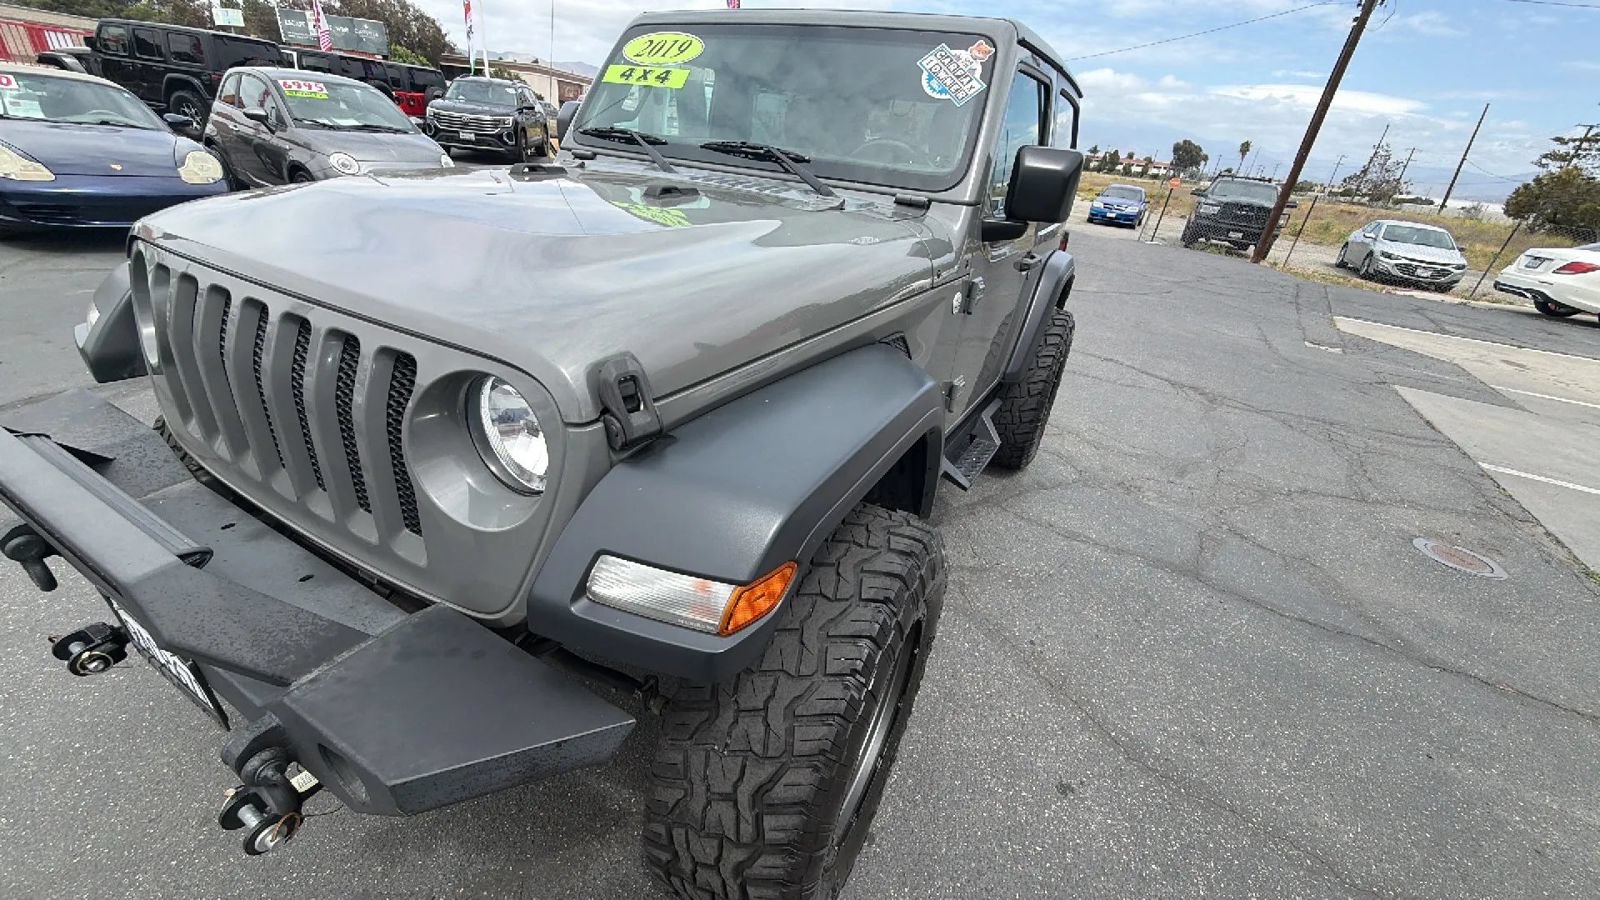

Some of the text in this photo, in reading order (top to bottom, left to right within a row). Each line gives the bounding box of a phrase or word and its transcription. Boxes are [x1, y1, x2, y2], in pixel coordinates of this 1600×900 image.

[633, 39, 694, 58] 2019
[930, 63, 969, 101] OWNER
[934, 50, 976, 92] CARFAX
